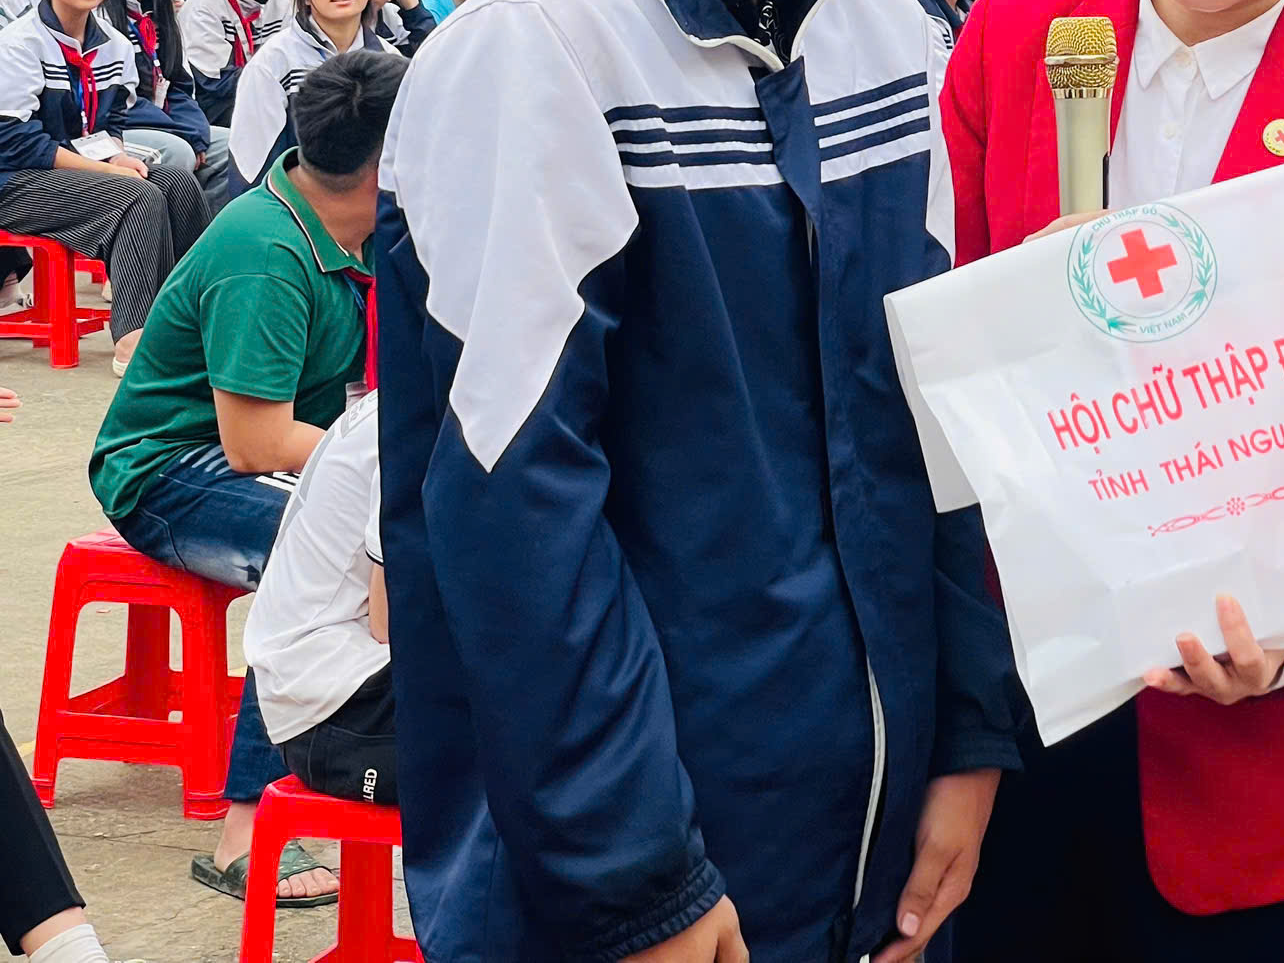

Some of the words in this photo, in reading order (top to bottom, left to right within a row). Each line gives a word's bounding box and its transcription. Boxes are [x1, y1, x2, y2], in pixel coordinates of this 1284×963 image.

[1163, 312, 1188, 329] NAM
[1047, 392, 1112, 455] HỘI
[1112, 364, 1183, 435] CHỮ
[1182, 342, 1269, 410] THẬP
[1088, 469, 1150, 500] TỈNH
[1159, 442, 1224, 484] THÁI
